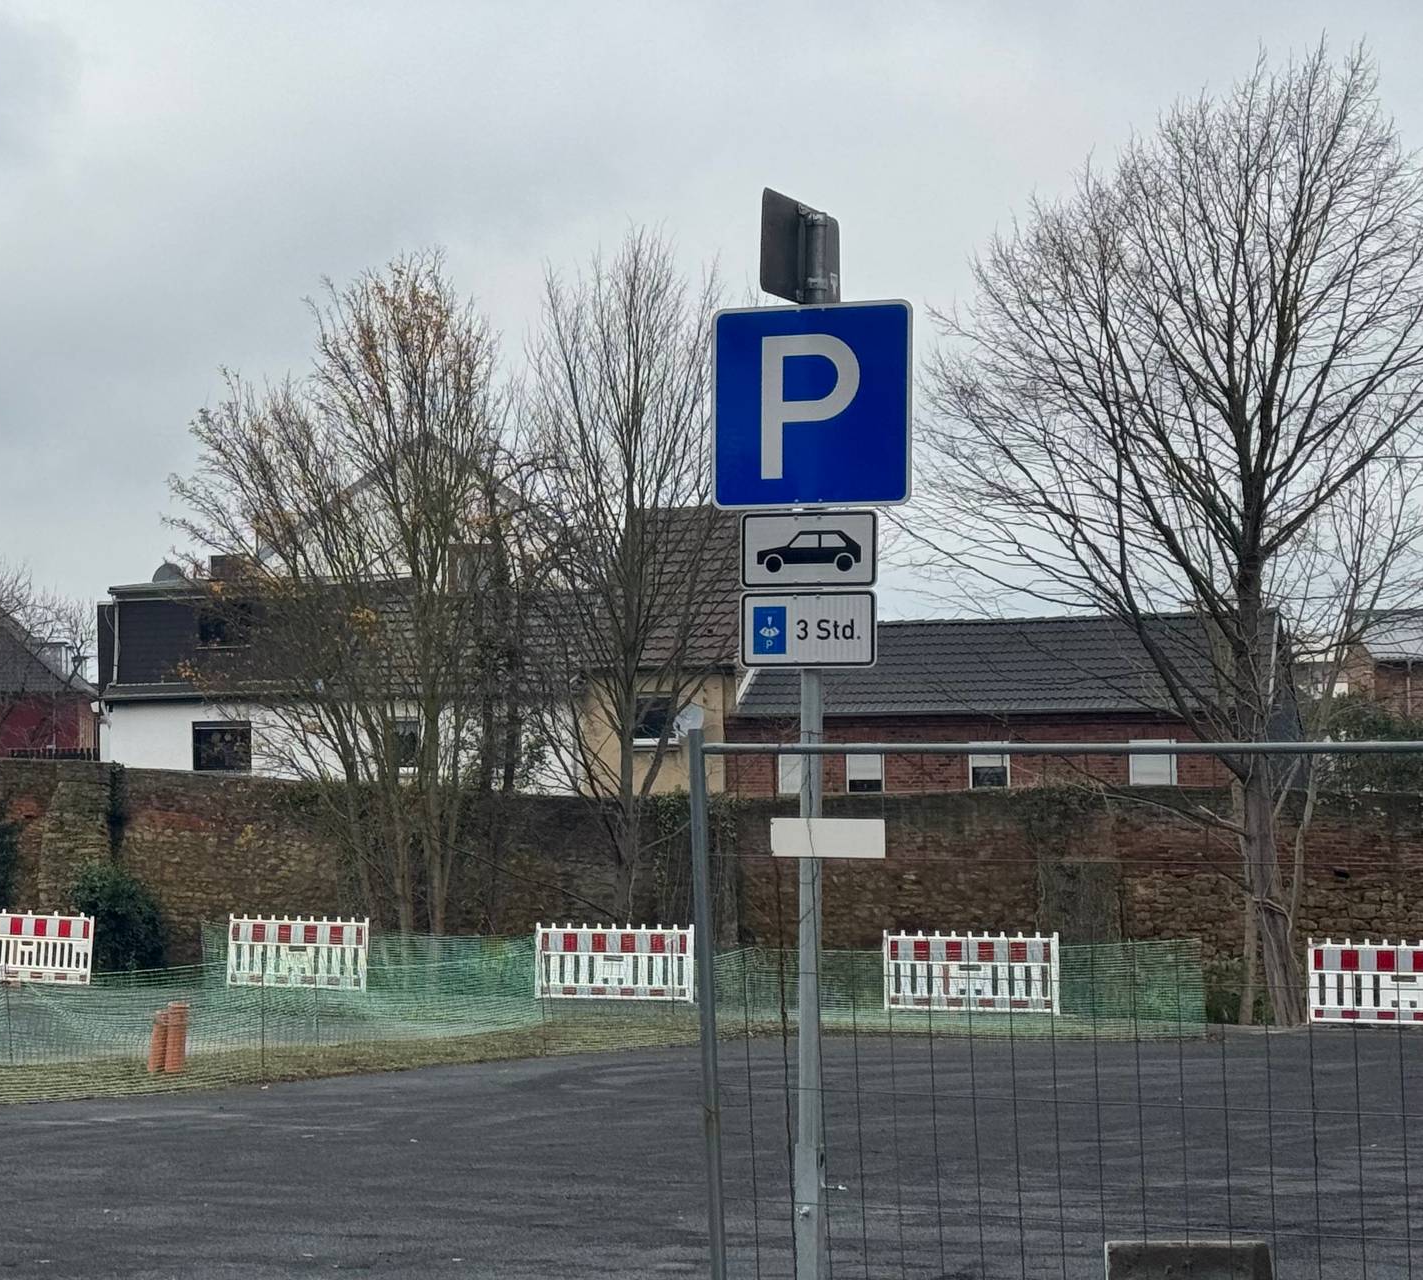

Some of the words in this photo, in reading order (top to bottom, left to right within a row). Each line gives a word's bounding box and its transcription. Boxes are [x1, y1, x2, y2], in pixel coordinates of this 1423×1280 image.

[760, 333, 861, 480] P
[796, 618, 809, 641] 3
[816, 617, 862, 641] Std.
[765, 639, 774, 650] P
